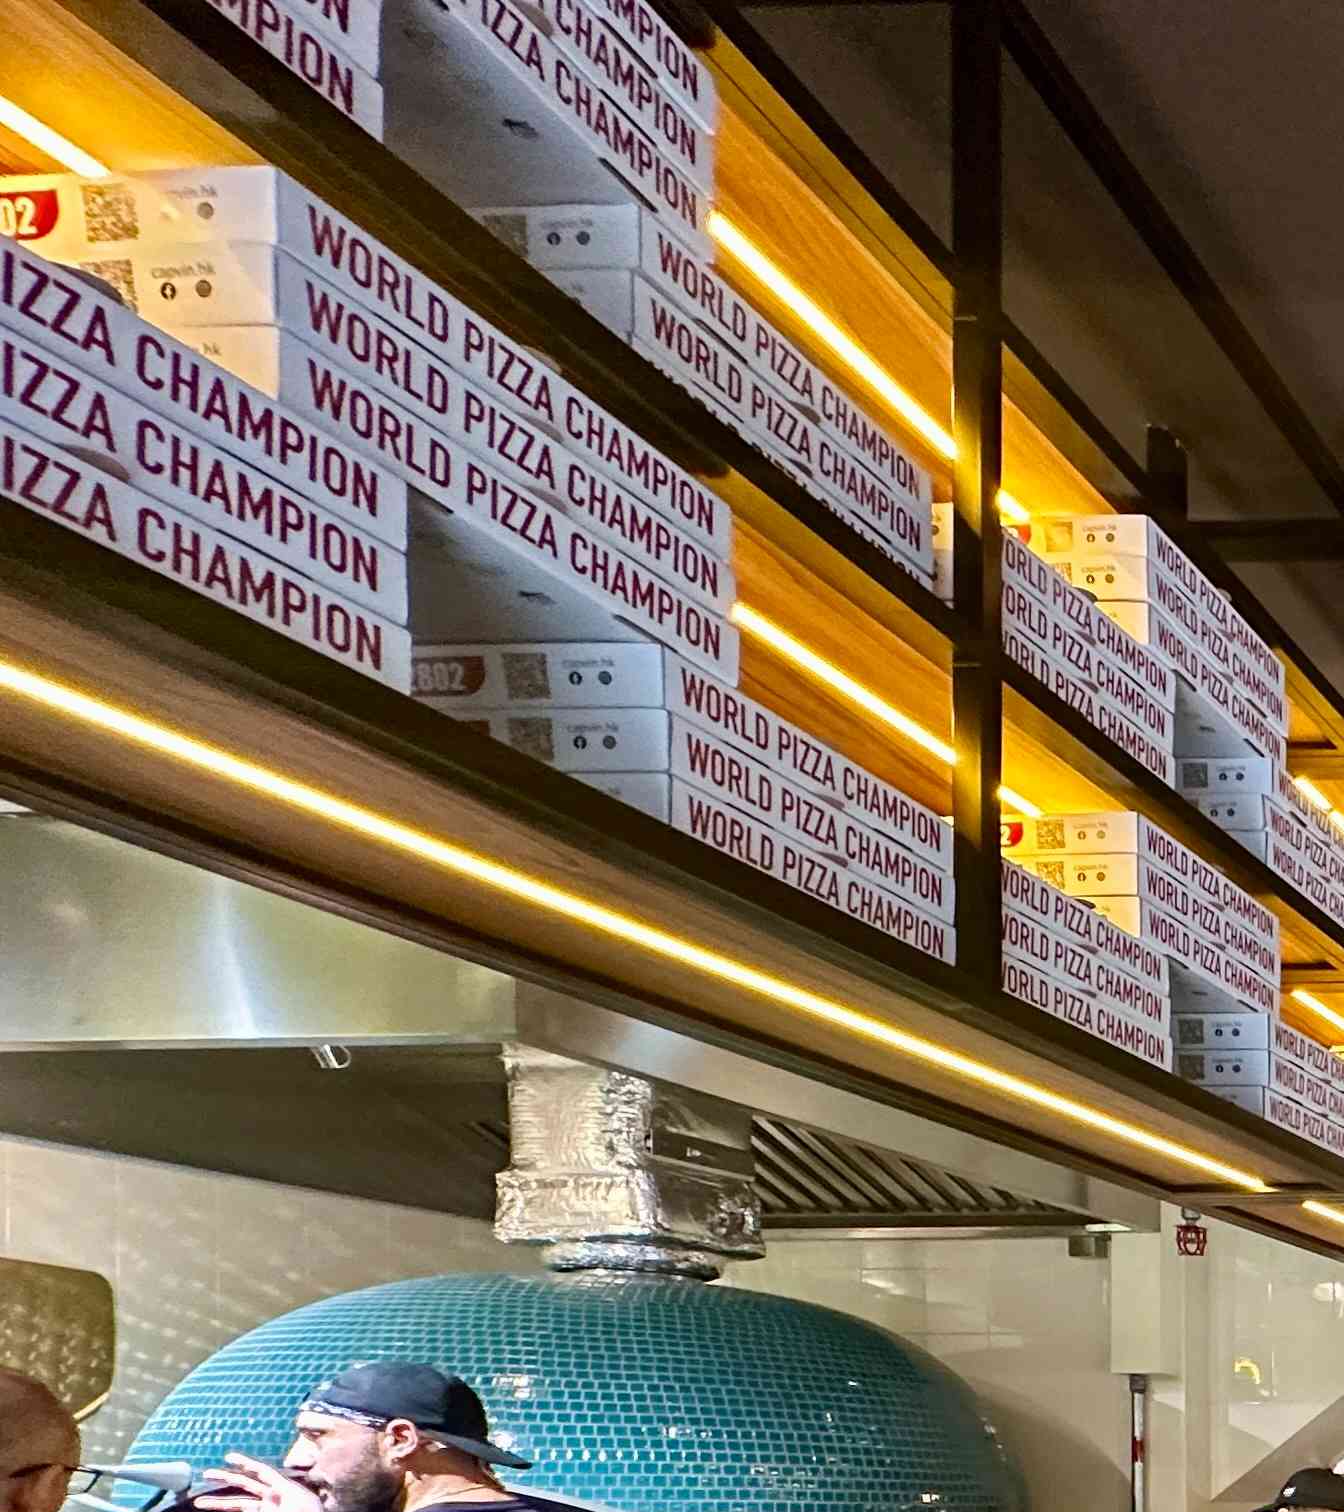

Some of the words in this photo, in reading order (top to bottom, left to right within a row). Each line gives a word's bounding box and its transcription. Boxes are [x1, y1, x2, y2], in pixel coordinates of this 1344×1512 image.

[481, 0, 545, 81] IZZA
[556, 60, 697, 229] CHAMPION
[556, 0, 695, 164] CHAMPION
[606, 0, 698, 101] MPION
[3, 250, 115, 367] IZZA
[136, 334, 378, 518] CHAMPION
[306, 280, 449, 415] WORLD
[465, 390, 556, 490] PIZZA
[568, 464, 718, 598] CHAMPION
[307, 205, 449, 344] WORLD
[464, 319, 554, 421] PIZZA
[565, 396, 714, 536] CHAMPION
[651, 299, 742, 403] WORLD
[752, 386, 811, 463] PIZZA
[819, 443, 921, 552] CHAMPION
[658, 232, 746, 341] WORLD
[756, 322, 813, 401] PIZZA
[822, 386, 920, 501] CHAMPION
[3, 341, 117, 453] IZZA
[136, 419, 379, 592] CHAMPION
[307, 358, 451, 489] WORLD
[466, 463, 559, 559] PIZZA
[570, 532, 720, 661] CHAMPION
[3, 436, 118, 543] IZZA
[138, 507, 382, 671] CHAMPION
[1005, 540, 1047, 595] ORLD
[1053, 580, 1092, 635] PIZZA
[1098, 617, 1166, 697] CHAMPION
[1156, 533, 1196, 594] WORLD
[1200, 579, 1227, 627] PIZZA
[1230, 614, 1279, 685] CHAMPION
[1053, 622, 1092, 678] PIZZA
[1097, 660, 1165, 738] CHAMPION
[1156, 573, 1197, 635] WORLD
[1201, 621, 1229, 670] PIZZA
[1232, 653, 1282, 722] CHAMPION
[1158, 621, 1197, 679] WORLD
[1201, 665, 1229, 712] PIZZA
[1232, 694, 1280, 760] CHAMPION
[681, 667, 769, 751] WORLD
[778, 725, 835, 792] PIZZA
[843, 767, 941, 852] CHAMPION
[1055, 671, 1094, 722] PIZZA
[1099, 706, 1166, 779] CHAMPION
[687, 733, 772, 812] WORLD
[782, 788, 838, 851] PIZZA
[846, 825, 942, 908] CHAMPION
[688, 795, 773, 871] WORLD
[783, 846, 840, 907] PIZZA
[848, 881, 944, 959] CHAMPION
[1146, 826, 1188, 876] WORLD
[1192, 860, 1220, 898] PIZZA
[1223, 883, 1274, 939] CHAMPION
[1305, 836, 1327, 874] PIZZA
[1306, 873, 1327, 910] PIZZA
[1054, 897, 1092, 943] PIZZA
[1096, 921, 1160, 981] CHAMPION
[1055, 942, 1092, 986] PIZZA
[1096, 965, 1161, 1023] CHAMPION
[1147, 866, 1188, 916] WORLD
[1193, 900, 1221, 939] PIZZA
[1224, 921, 1275, 976] CHAMPION
[1149, 908, 1189, 958] WORLD
[1193, 940, 1222, 980] PIZZA
[1225, 959, 1274, 1010] CHAMPION
[1054, 988, 1092, 1031] PIZZA
[1098, 1009, 1164, 1064] CHAMPION
